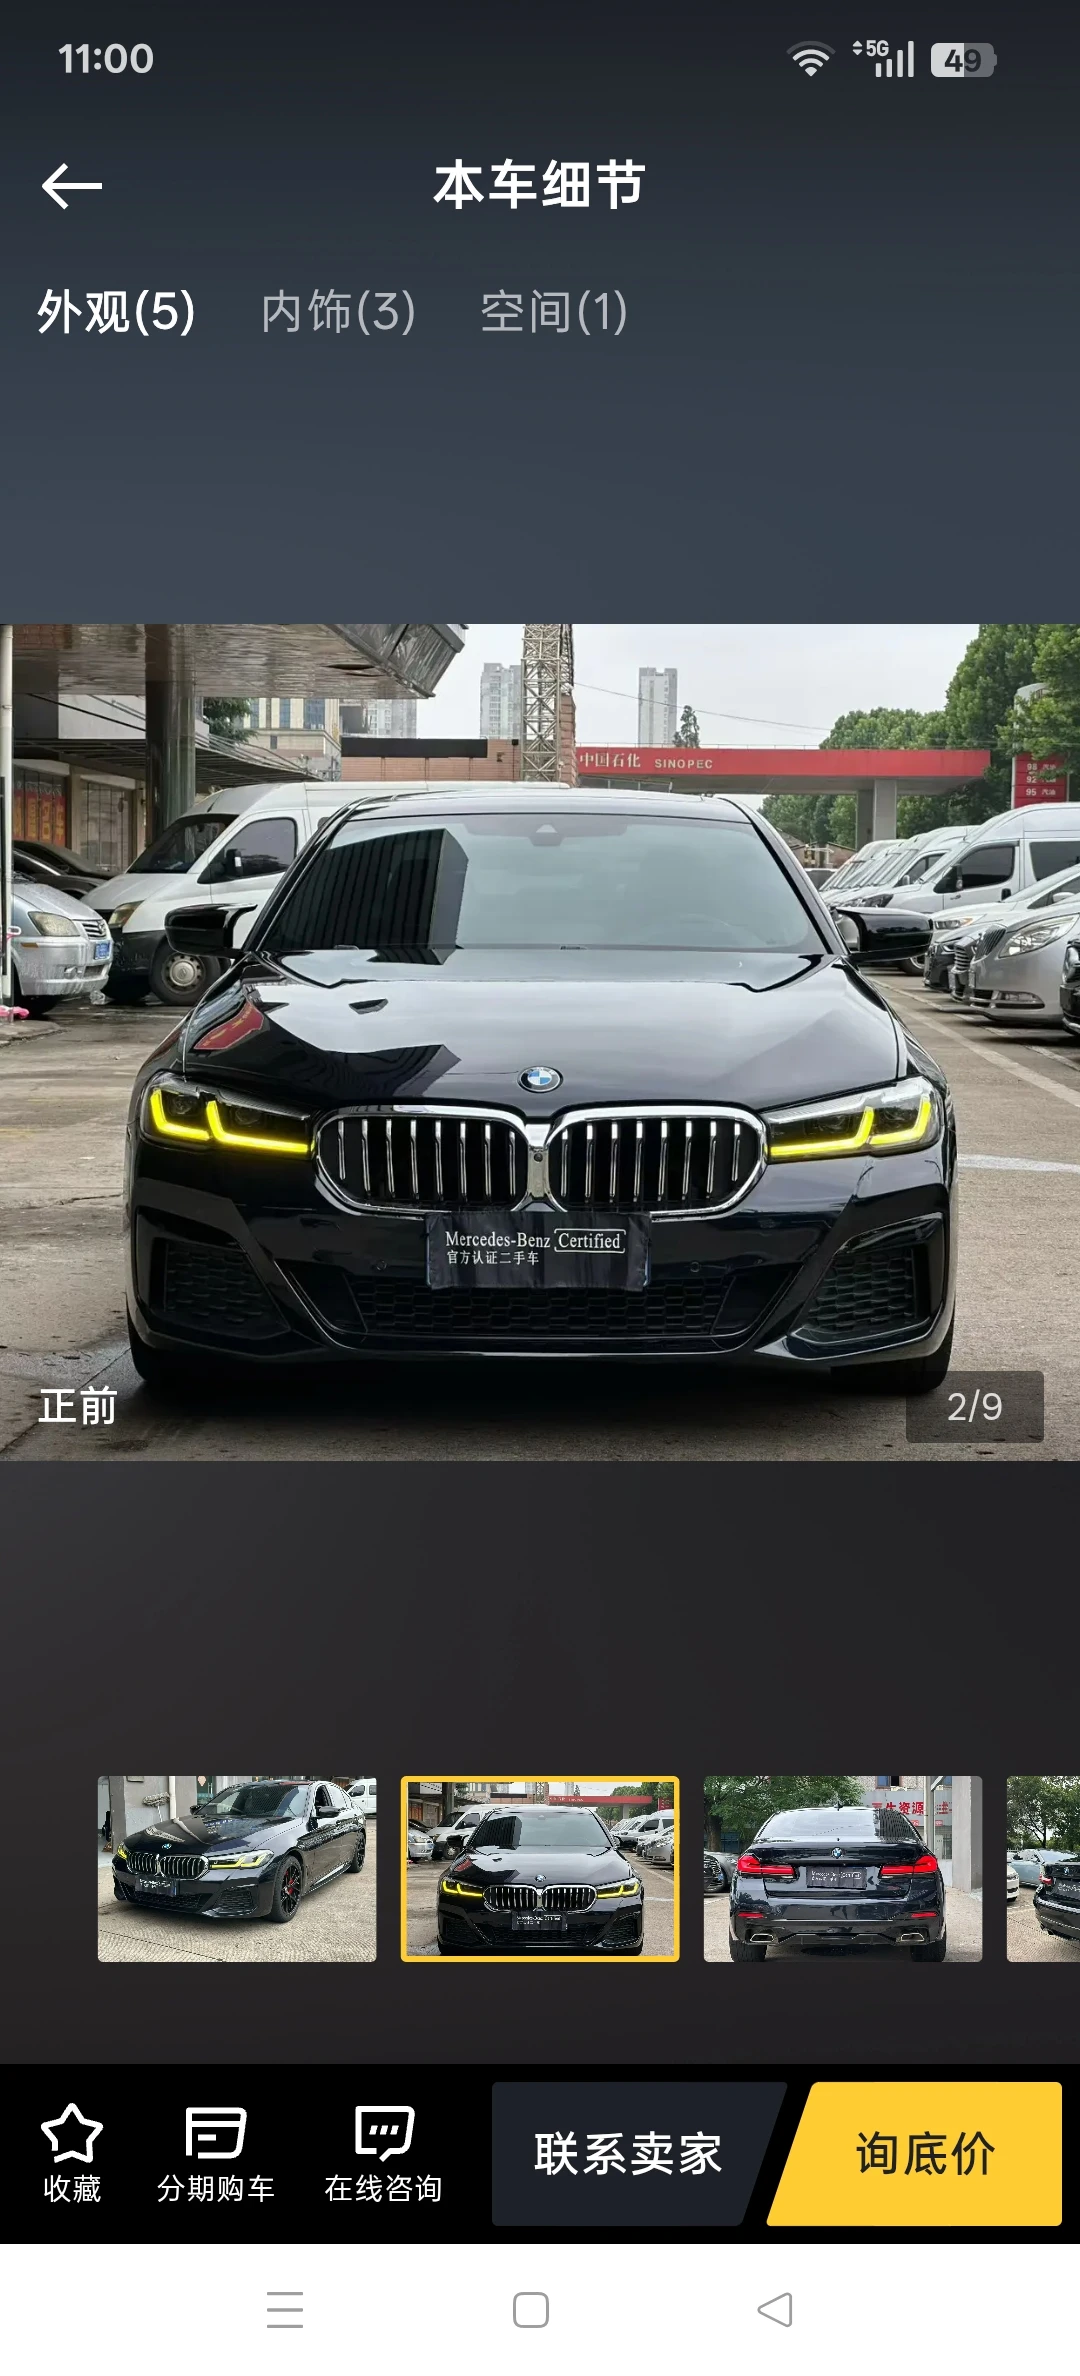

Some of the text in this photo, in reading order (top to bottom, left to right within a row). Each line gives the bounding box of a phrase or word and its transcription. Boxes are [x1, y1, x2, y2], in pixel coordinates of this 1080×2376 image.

[58, 42, 154, 74] 11:00
[865, 39, 890, 57] 5G
[944, 48, 982, 73] 49
[433, 158, 646, 209] 本车细节
[37, 288, 195, 336] 外观(5)
[262, 288, 415, 336] 内饰(3)
[480, 288, 627, 336] 空间(1)
[580, 752, 641, 768] 中国石化
[654, 758, 713, 769] SINOPEC
[1025, 788, 1037, 796] 95
[1026, 775, 1037, 784] 92
[445, 1231, 621, 1249] Mercedes-Benz Certified
[446, 1250, 540, 1266] 官方认证二手车
[38, 1386, 118, 1425] 正前
[947, 1388, 1003, 1423] 2/9
[533, 2130, 723, 2176] 联系卖家
[856, 2130, 996, 2176] 询底价
[43, 2173, 102, 2204] 收藏
[156, 2173, 276, 2203] 分期购车
[324, 2173, 443, 2203] 在线咨询
